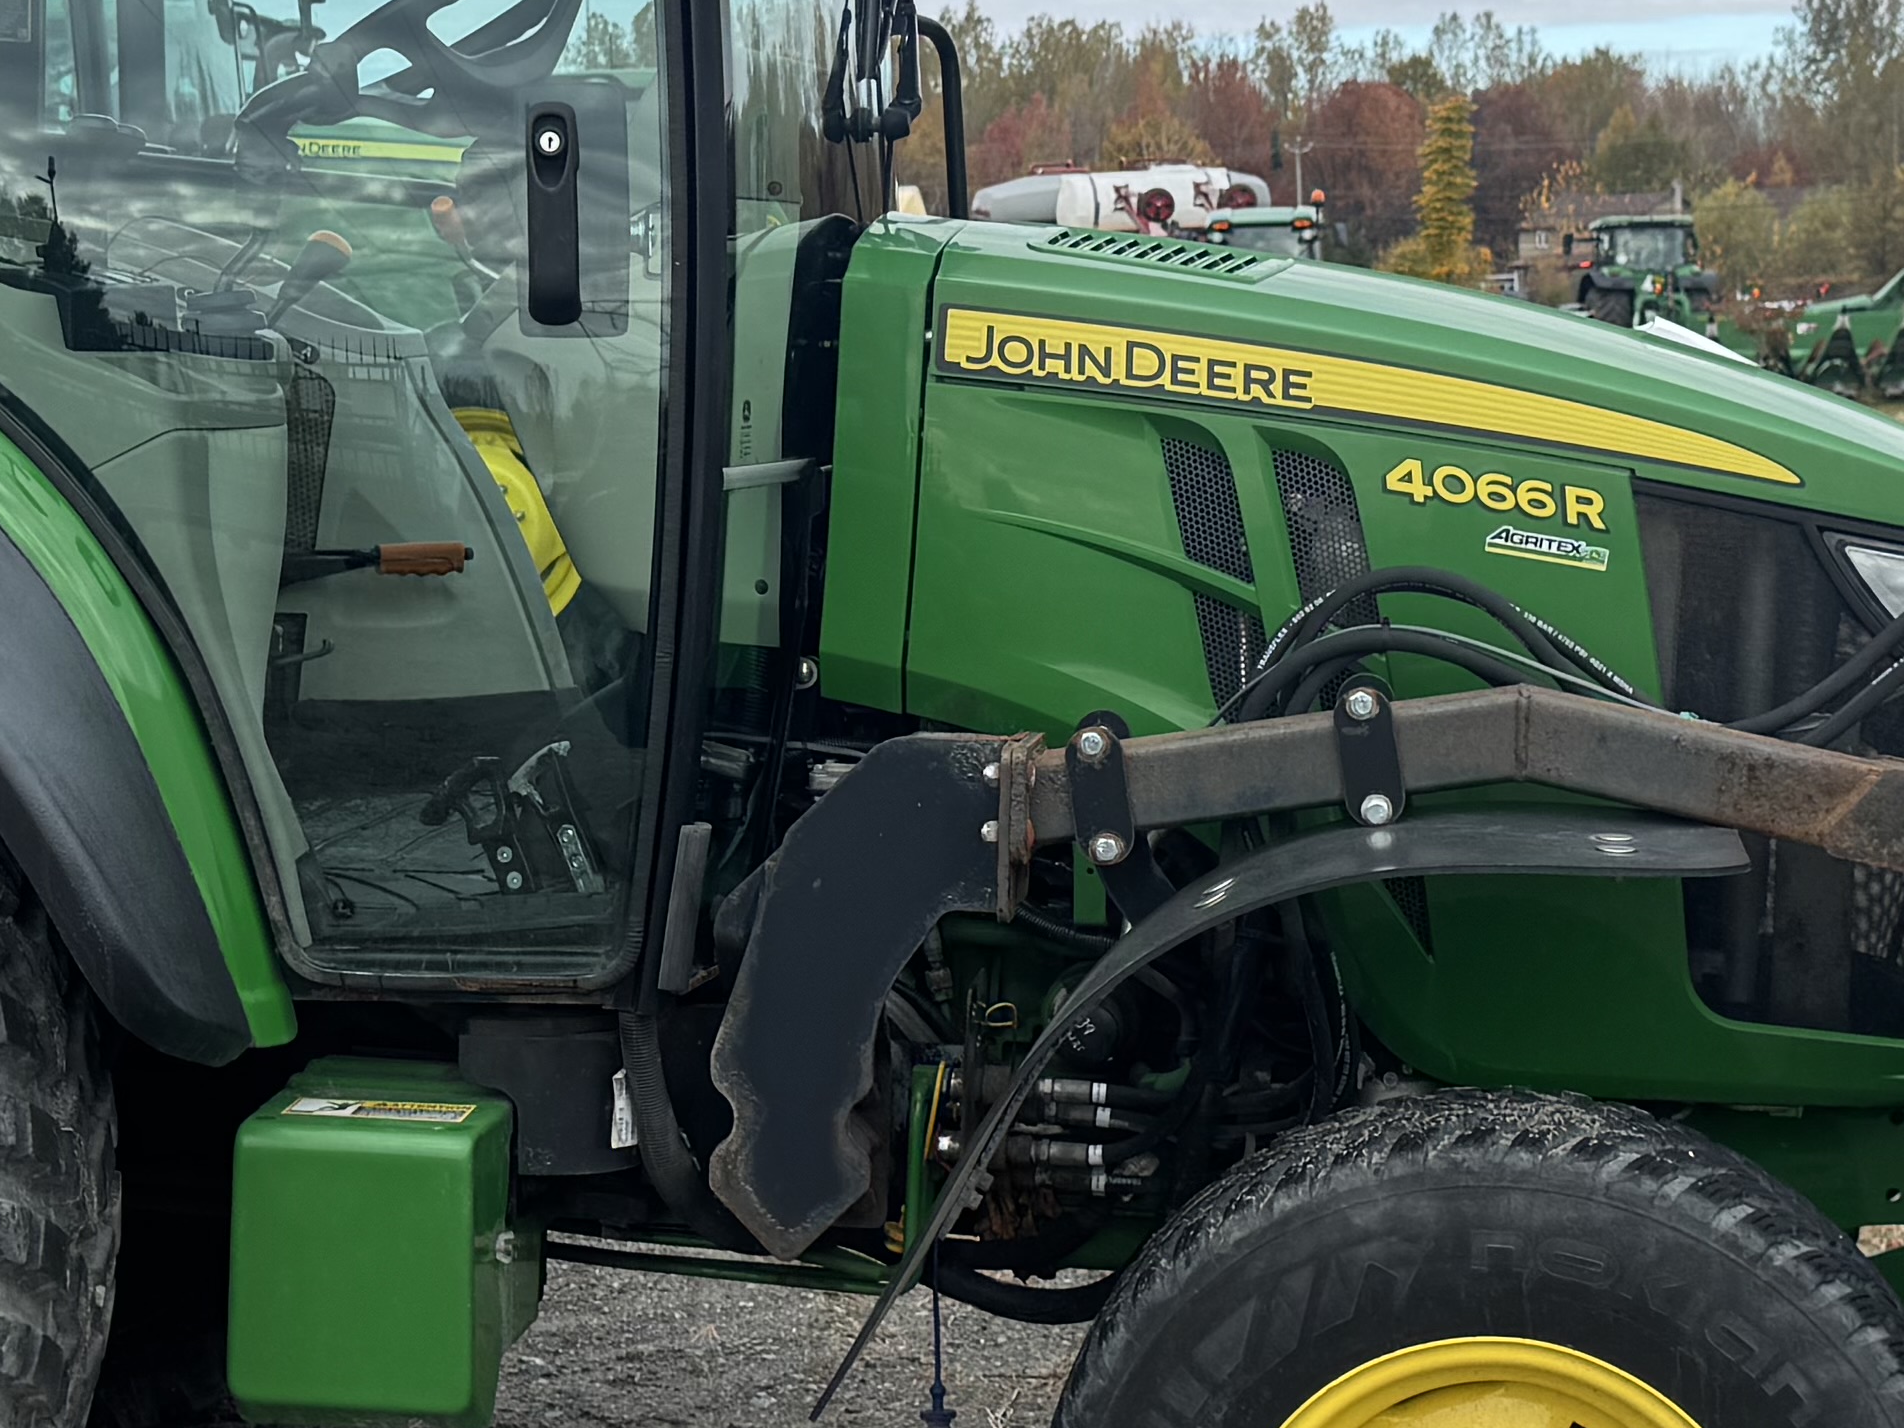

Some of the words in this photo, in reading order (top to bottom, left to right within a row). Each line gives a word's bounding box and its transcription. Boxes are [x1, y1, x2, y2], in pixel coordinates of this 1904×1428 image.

[965, 324, 1112, 379] JOHN
[1126, 339, 1313, 404] DEERE
[1385, 458, 1557, 518] 4066
[1564, 485, 1607, 531] R
[1489, 528, 1582, 555] AGRITEX
